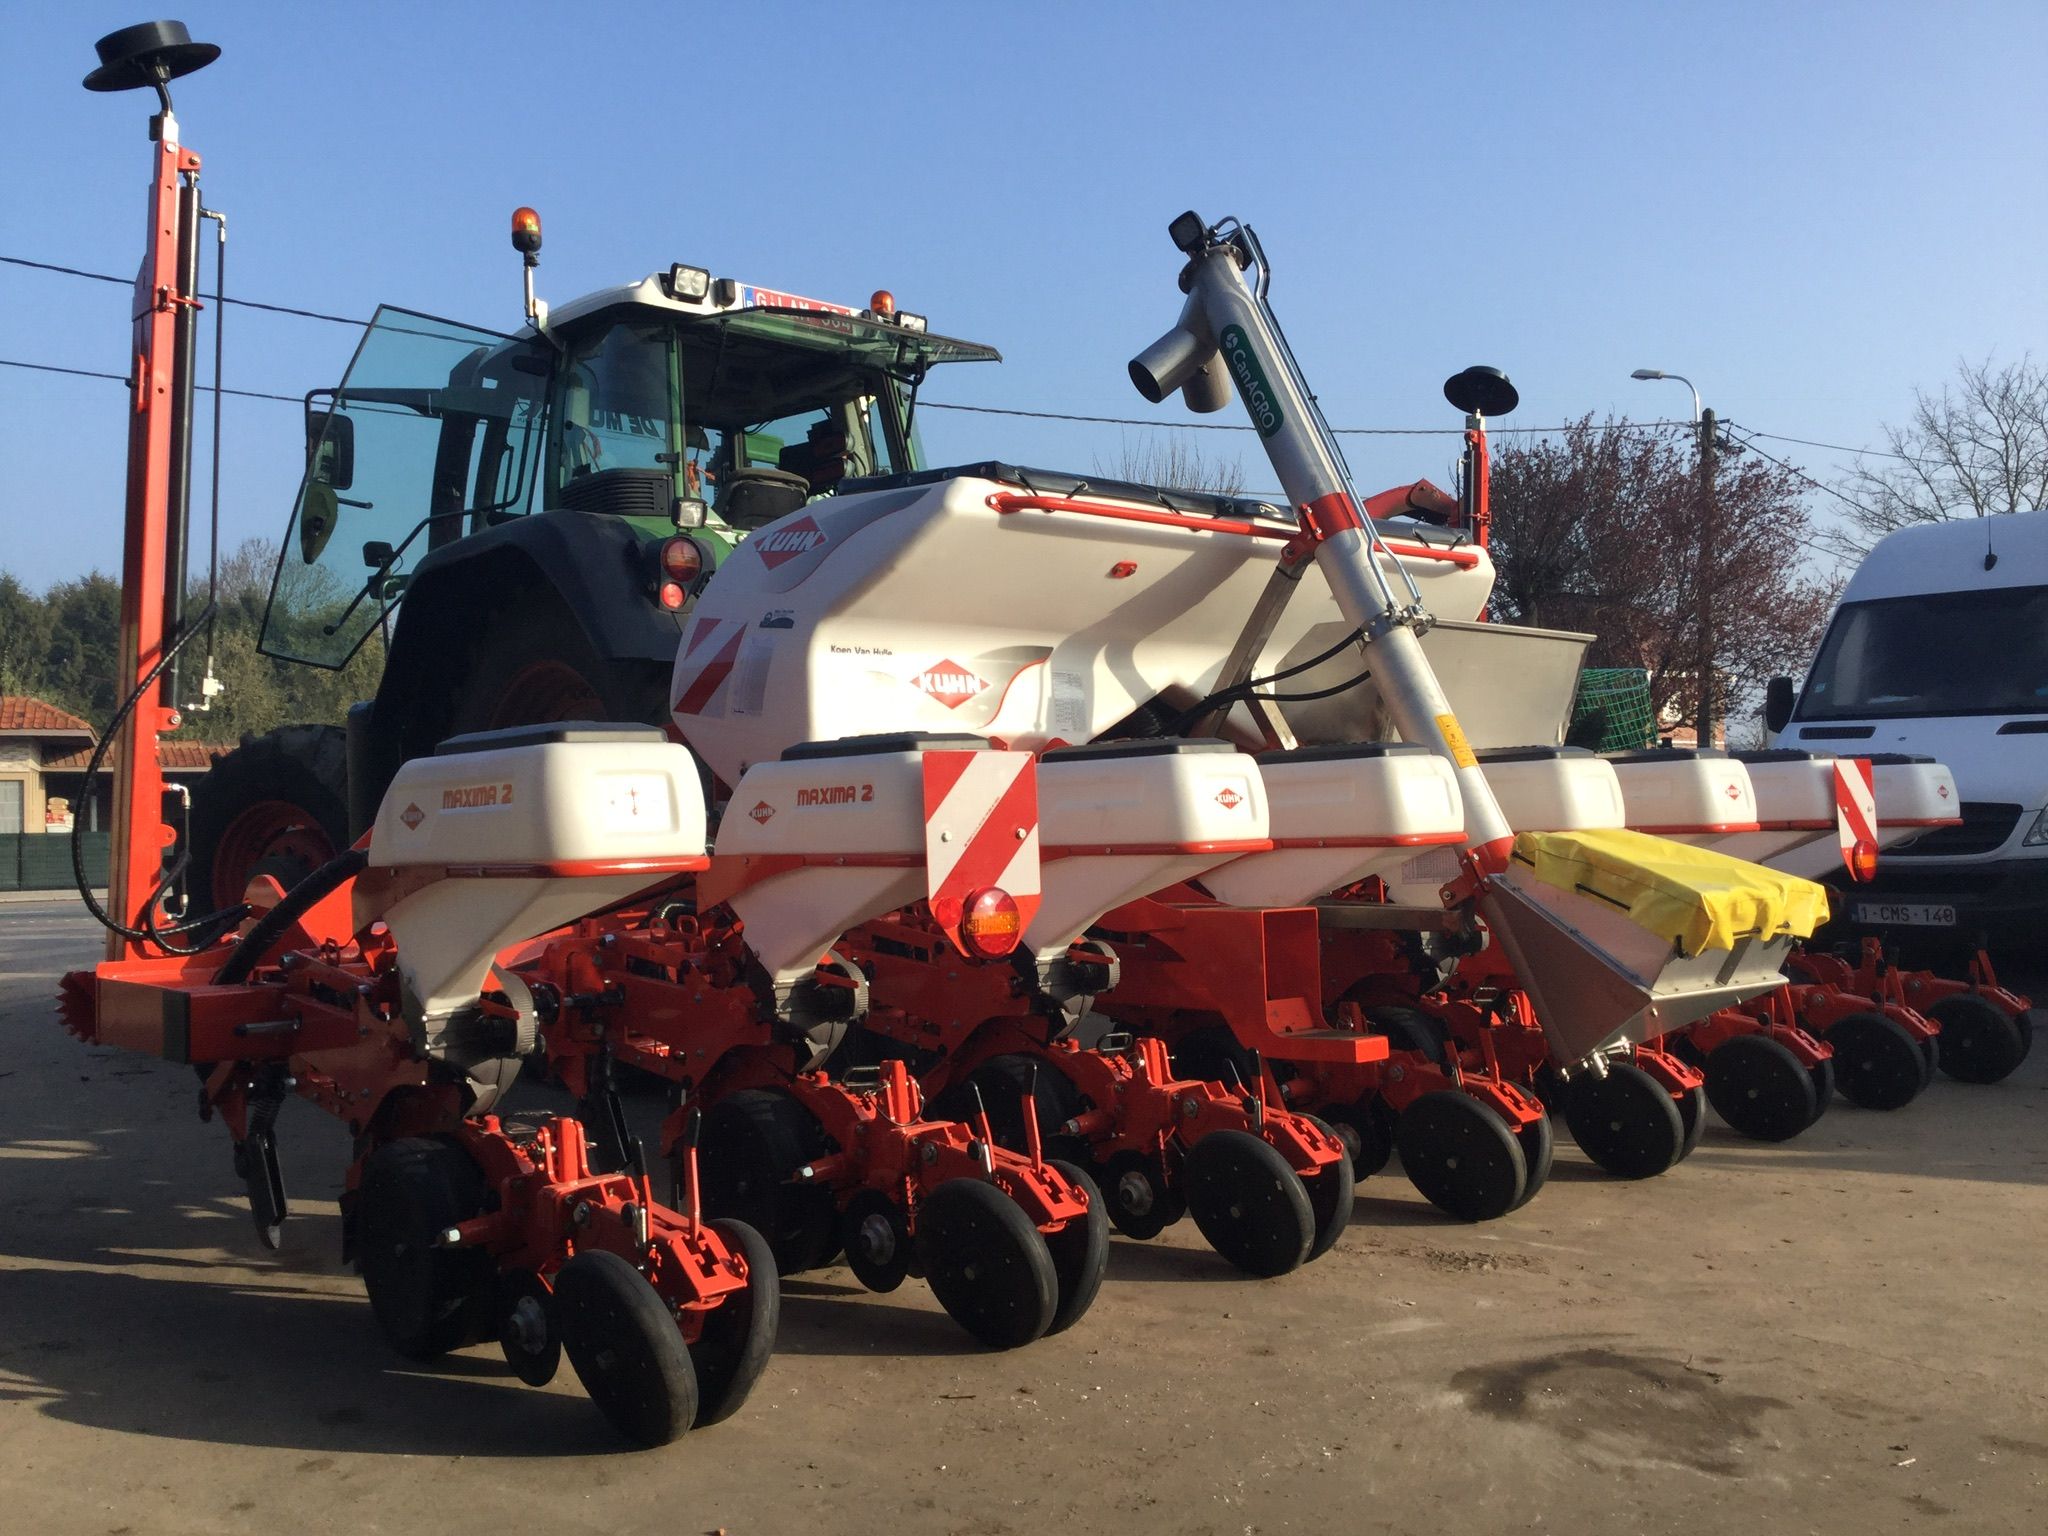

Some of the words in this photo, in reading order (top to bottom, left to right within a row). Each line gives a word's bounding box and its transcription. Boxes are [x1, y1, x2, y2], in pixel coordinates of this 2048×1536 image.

[1232, 349, 1275, 429] CanAGRO
[755, 531, 822, 551] KUHN
[830, 644, 851, 653] Koen
[854, 646, 870, 654] Van
[919, 672, 981, 694] KUHN
[442, 785, 497, 809] MAXIMA
[502, 784, 512, 804] 2
[797, 785, 856, 806] MAXIMA
[861, 784, 873, 801] 2
[751, 807, 774, 819] KUHN
